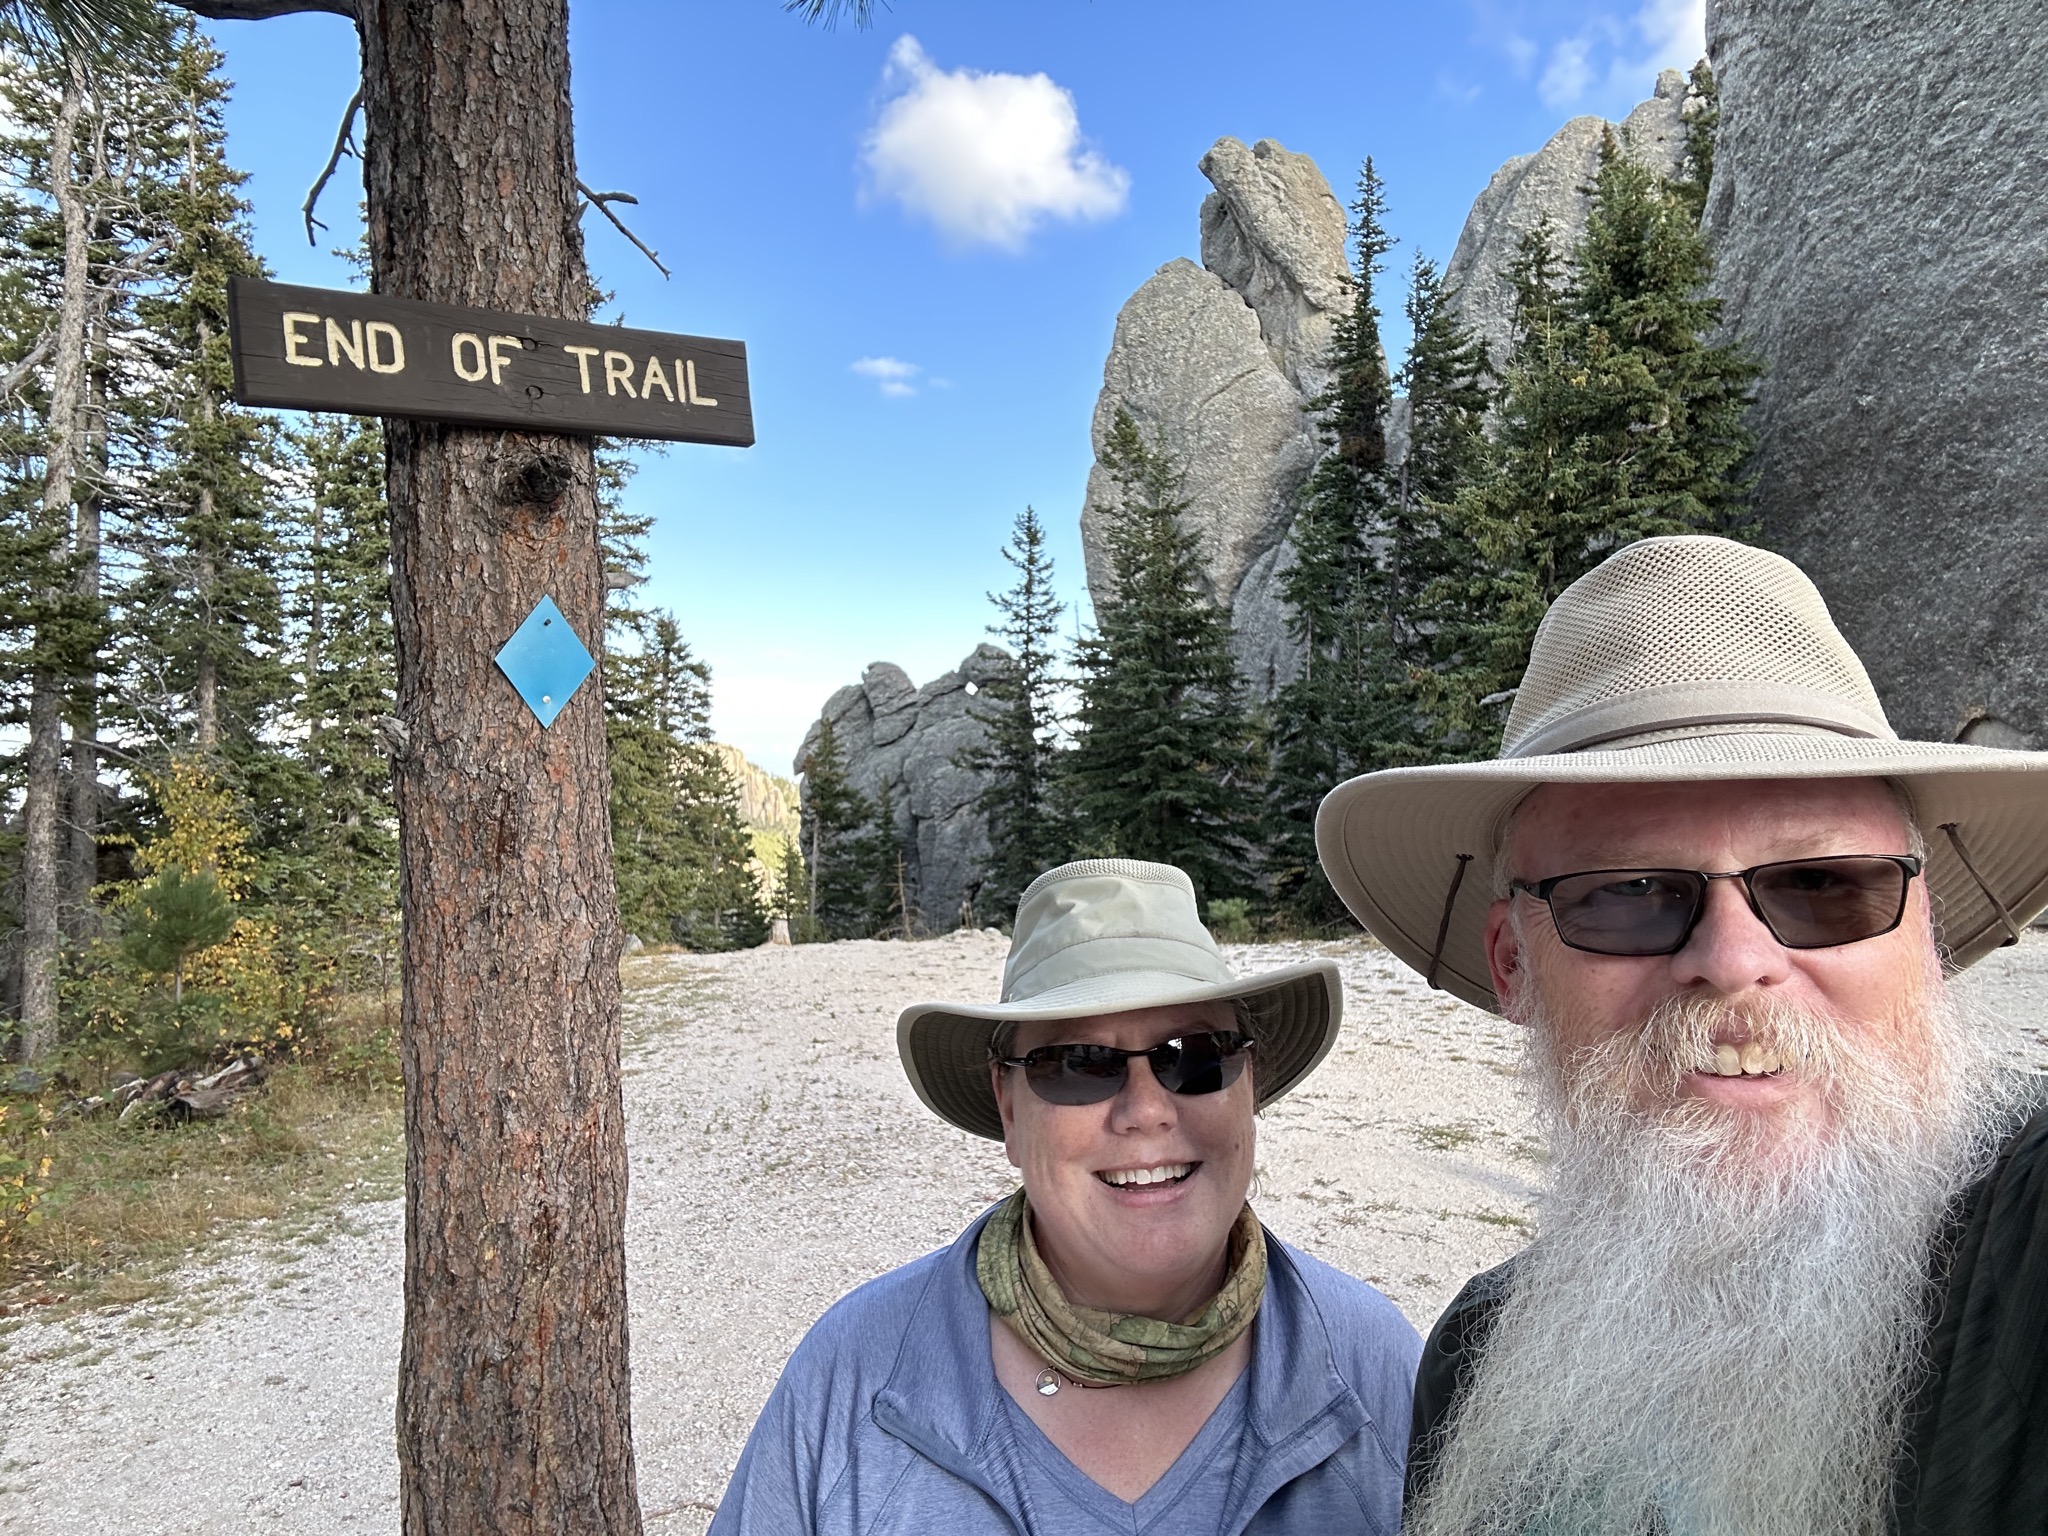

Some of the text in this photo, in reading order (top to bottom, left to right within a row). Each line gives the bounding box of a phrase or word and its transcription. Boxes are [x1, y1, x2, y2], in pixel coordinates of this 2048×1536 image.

[282, 311, 719, 408] END OF TRAIL
